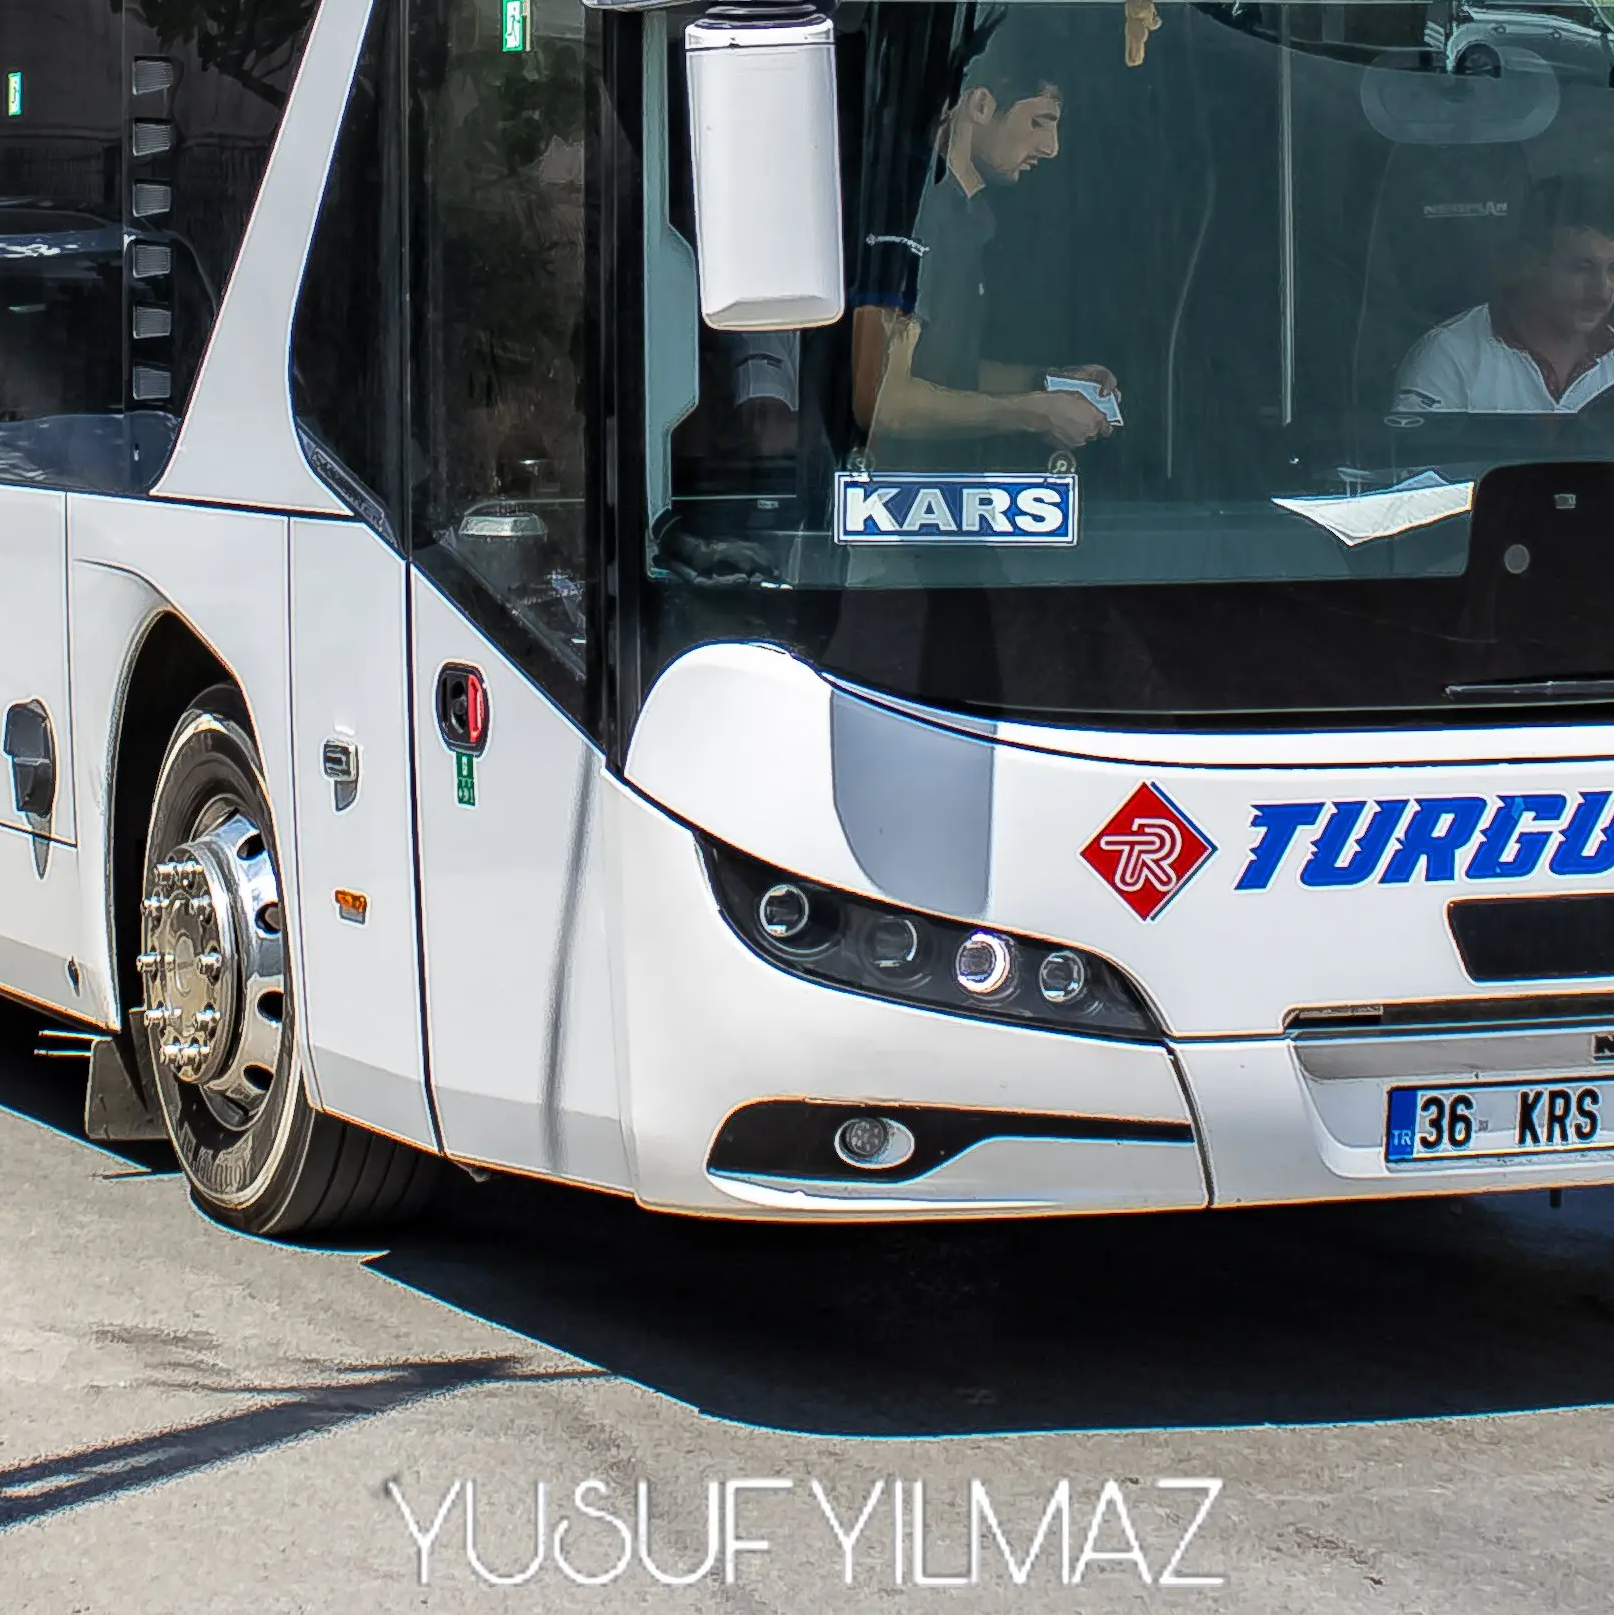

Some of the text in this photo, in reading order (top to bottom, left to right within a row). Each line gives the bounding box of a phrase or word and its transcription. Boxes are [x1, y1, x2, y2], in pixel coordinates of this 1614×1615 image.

[845, 486, 1064, 534] KARS
[1392, 1129, 1412, 1147] TR
[1418, 1093, 1475, 1151] 36
[1517, 1086, 1600, 1146] KRS
